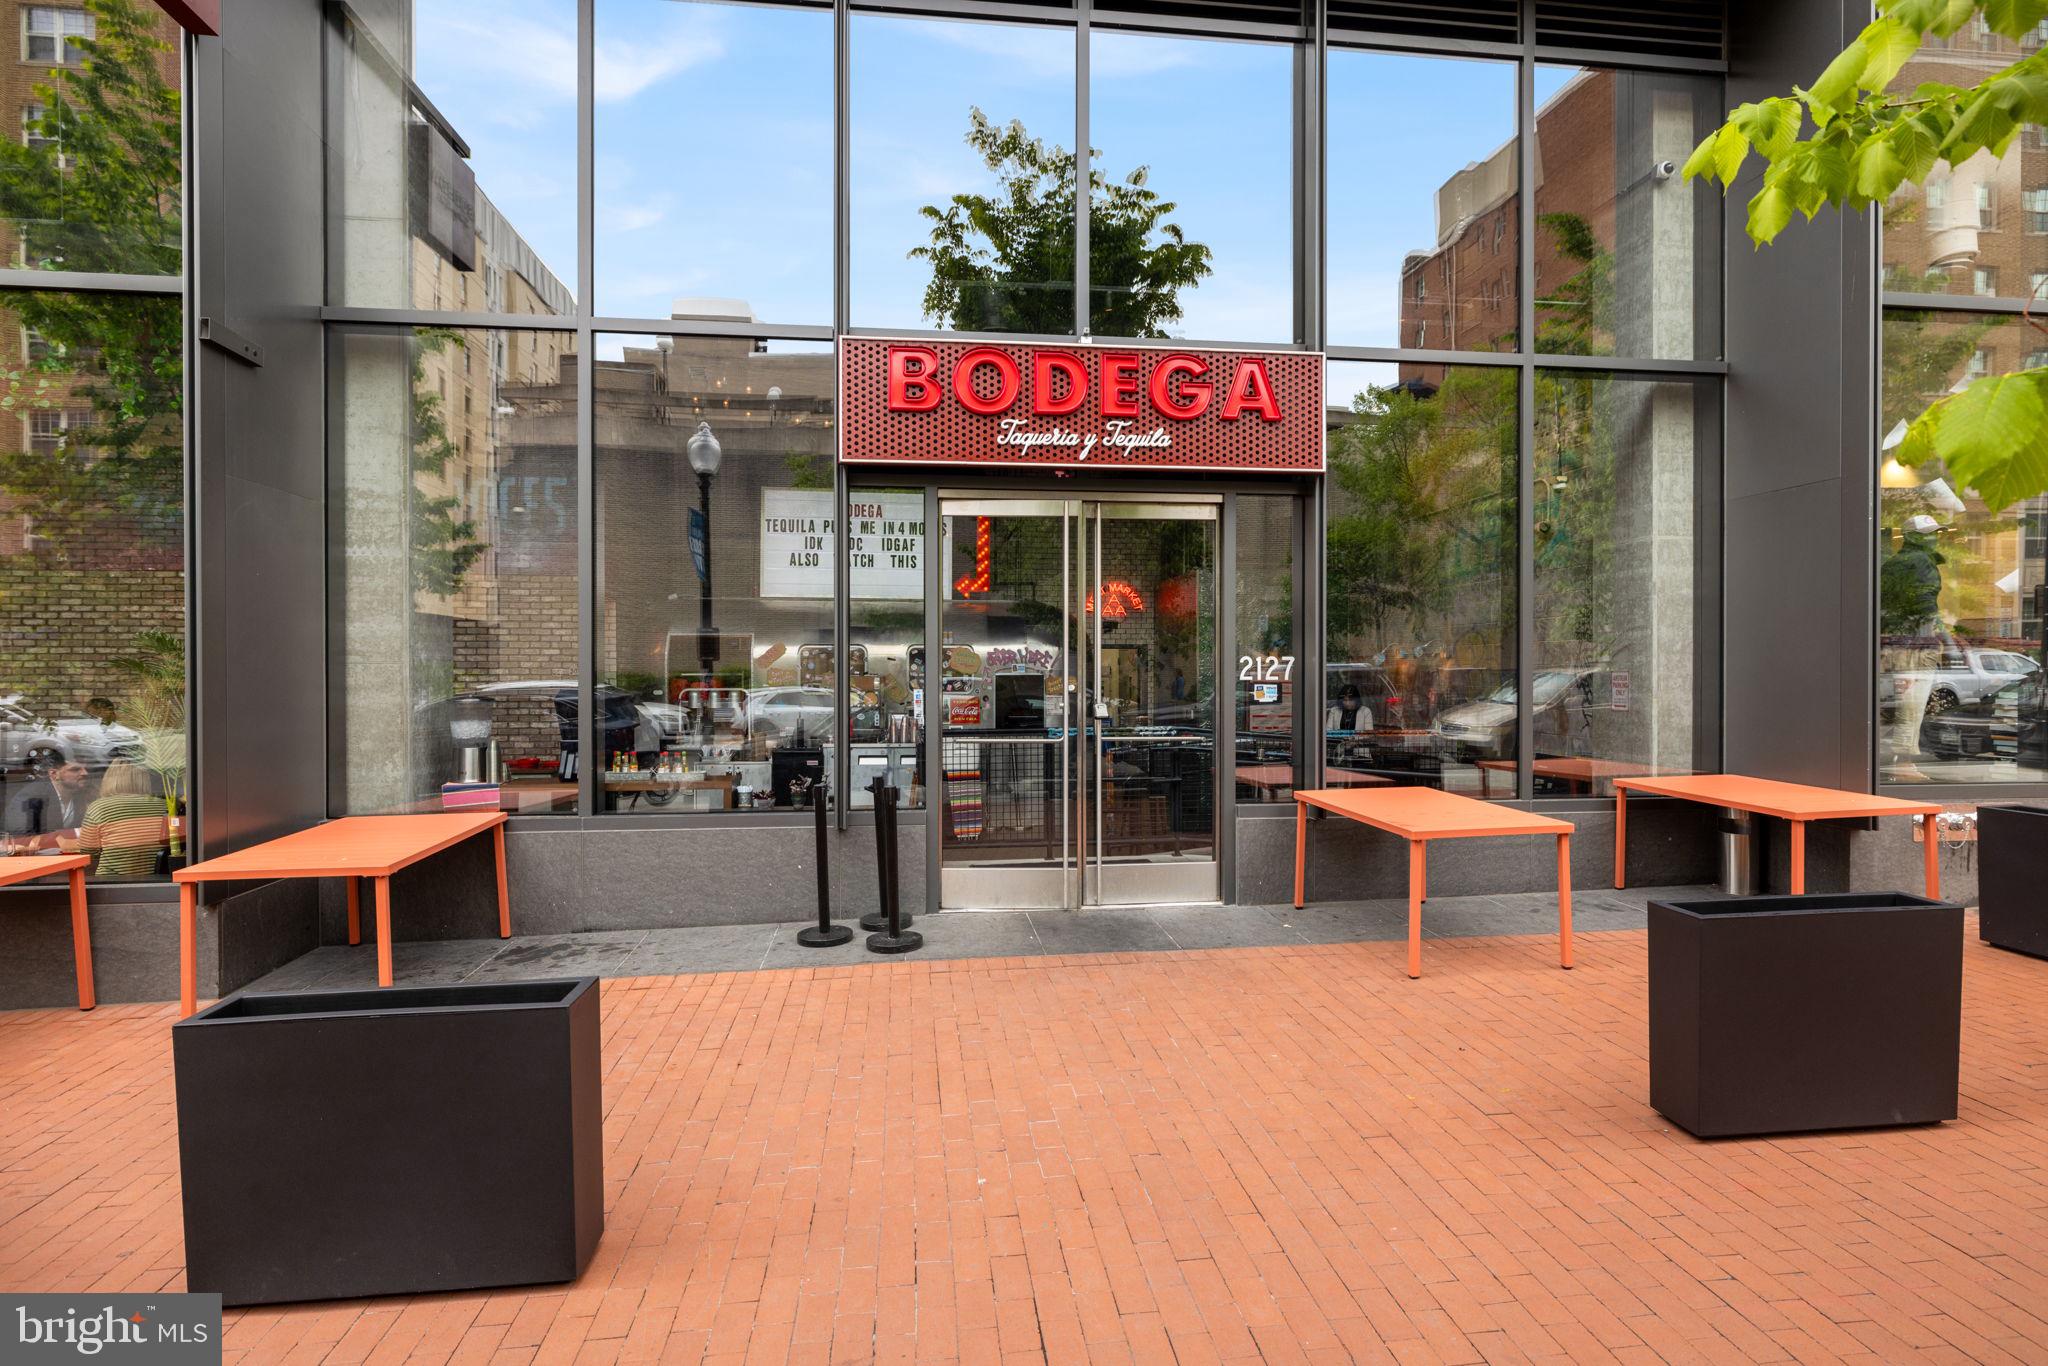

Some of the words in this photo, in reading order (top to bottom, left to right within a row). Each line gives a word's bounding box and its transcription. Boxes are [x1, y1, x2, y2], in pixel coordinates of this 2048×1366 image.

[888, 345, 1283, 422] BODEGA
[1078, 433, 1098, 460] y
[1102, 421, 1172, 456] Tequila
[848, 504, 883, 518] ODEGA
[765, 518, 816, 533] TEQUILA
[860, 521, 876, 534] ME
[883, 521, 894, 535] IN
[898, 521, 905, 535] 4
[804, 538, 823, 550] IDK
[881, 538, 916, 551] IDGAF
[789, 553, 819, 567] ALSO
[890, 555, 917, 568] THIS
[1239, 656, 1295, 681] 2127
